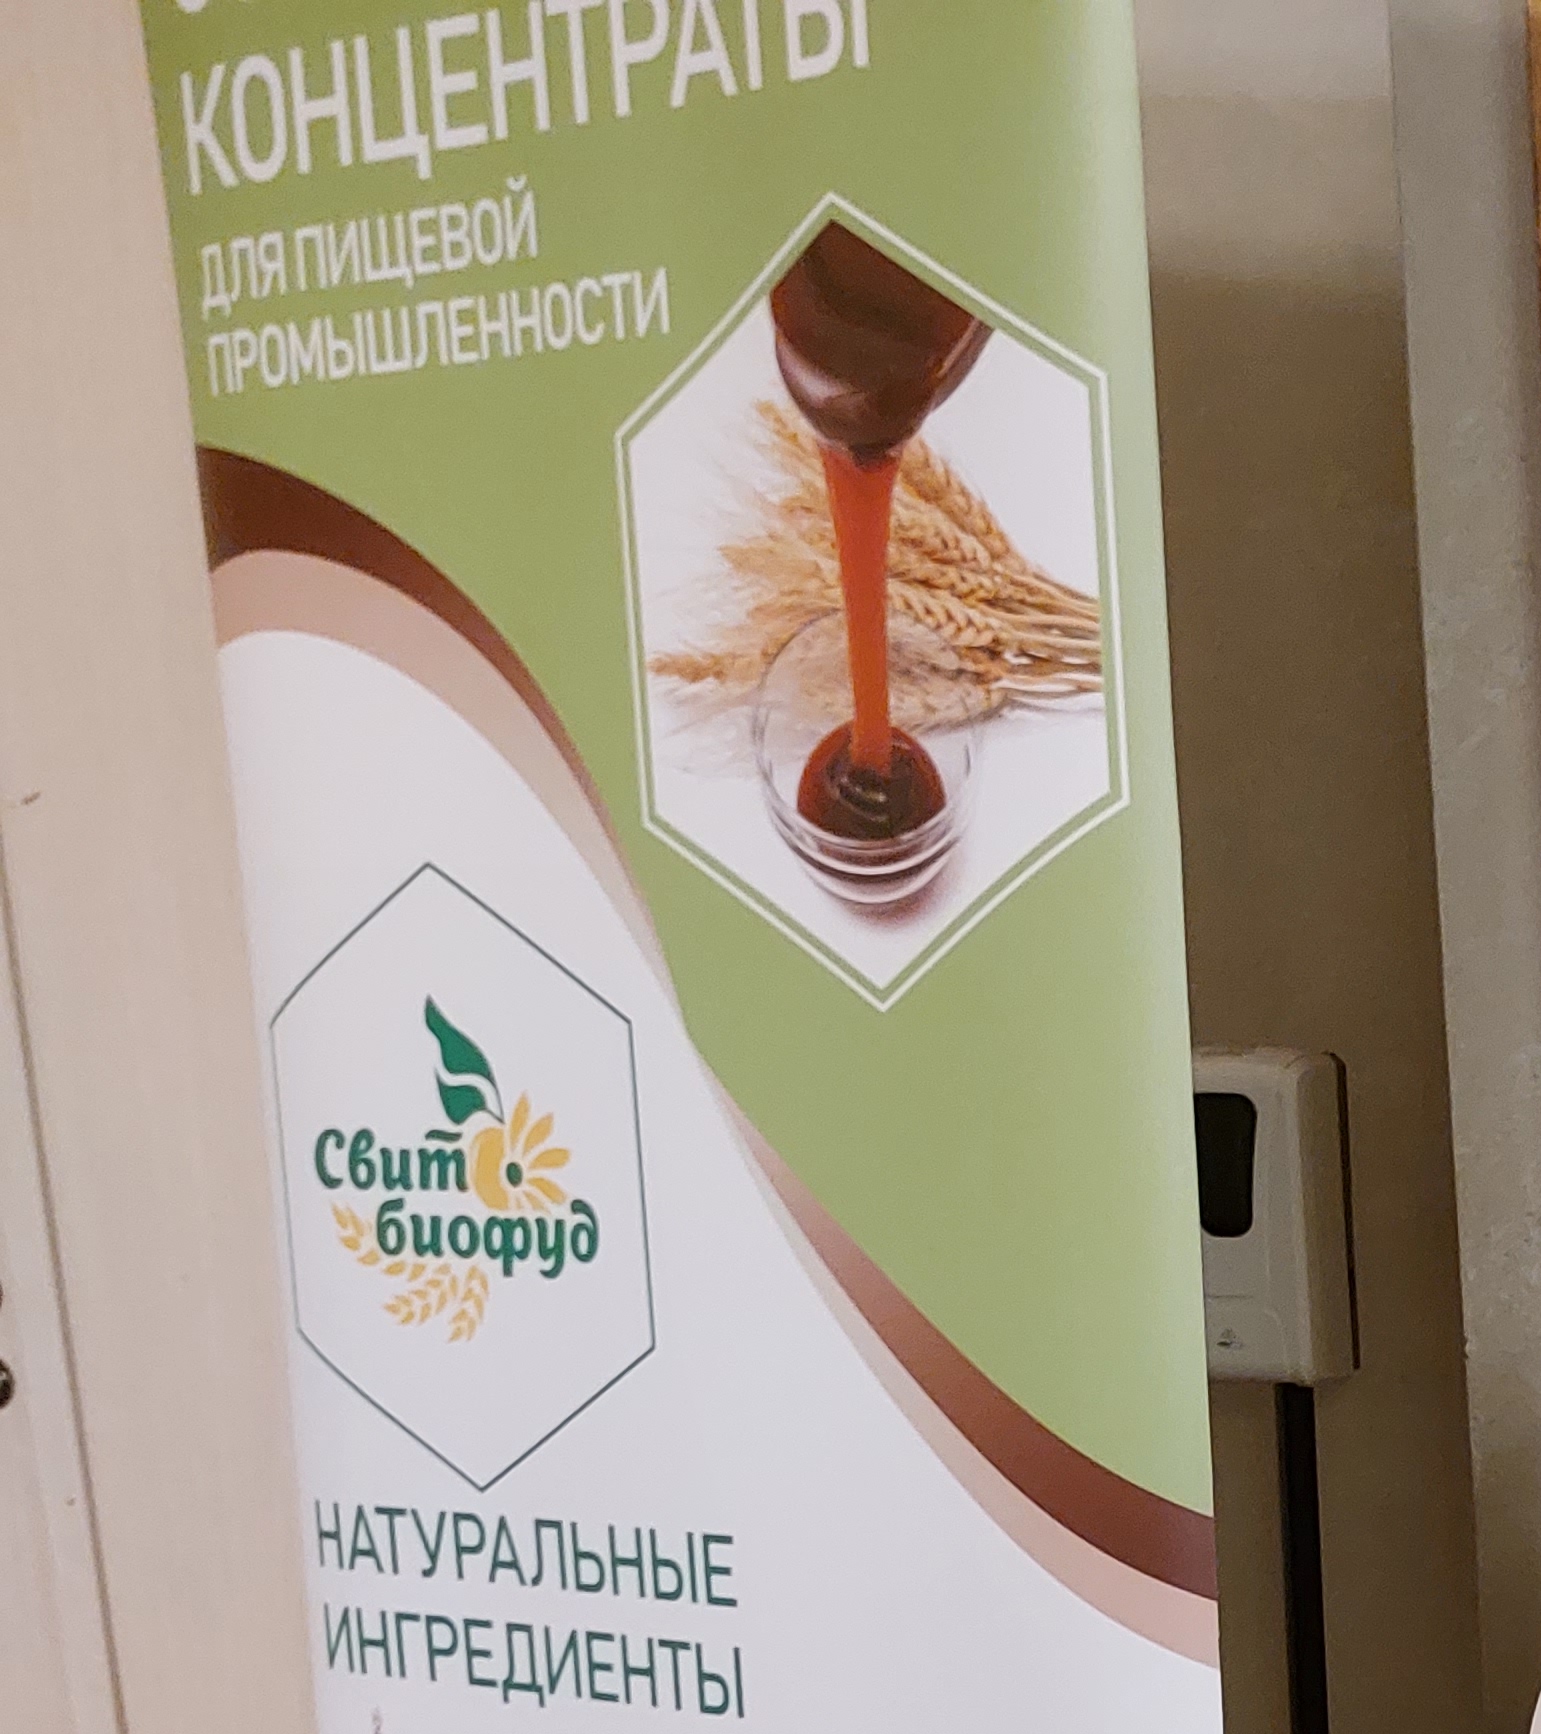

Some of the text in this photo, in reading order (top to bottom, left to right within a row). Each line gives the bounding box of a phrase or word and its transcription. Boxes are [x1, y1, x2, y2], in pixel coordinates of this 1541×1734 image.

[180, 0, 872, 196] КОНЦЕНТРАТЫ
[200, 175, 540, 320] ДЛЯ ПИЩЕВОЙ
[206, 266, 671, 398] ПРОМЫШЛЕННОСТИ
[315, 1128, 468, 1192] Свит
[376, 1198, 599, 1279] биофуд
[314, 1499, 738, 1607] НАТУРАЛЬНЫЕ
[323, 1602, 745, 1719] ИНГРЕДИЕНТЫ
